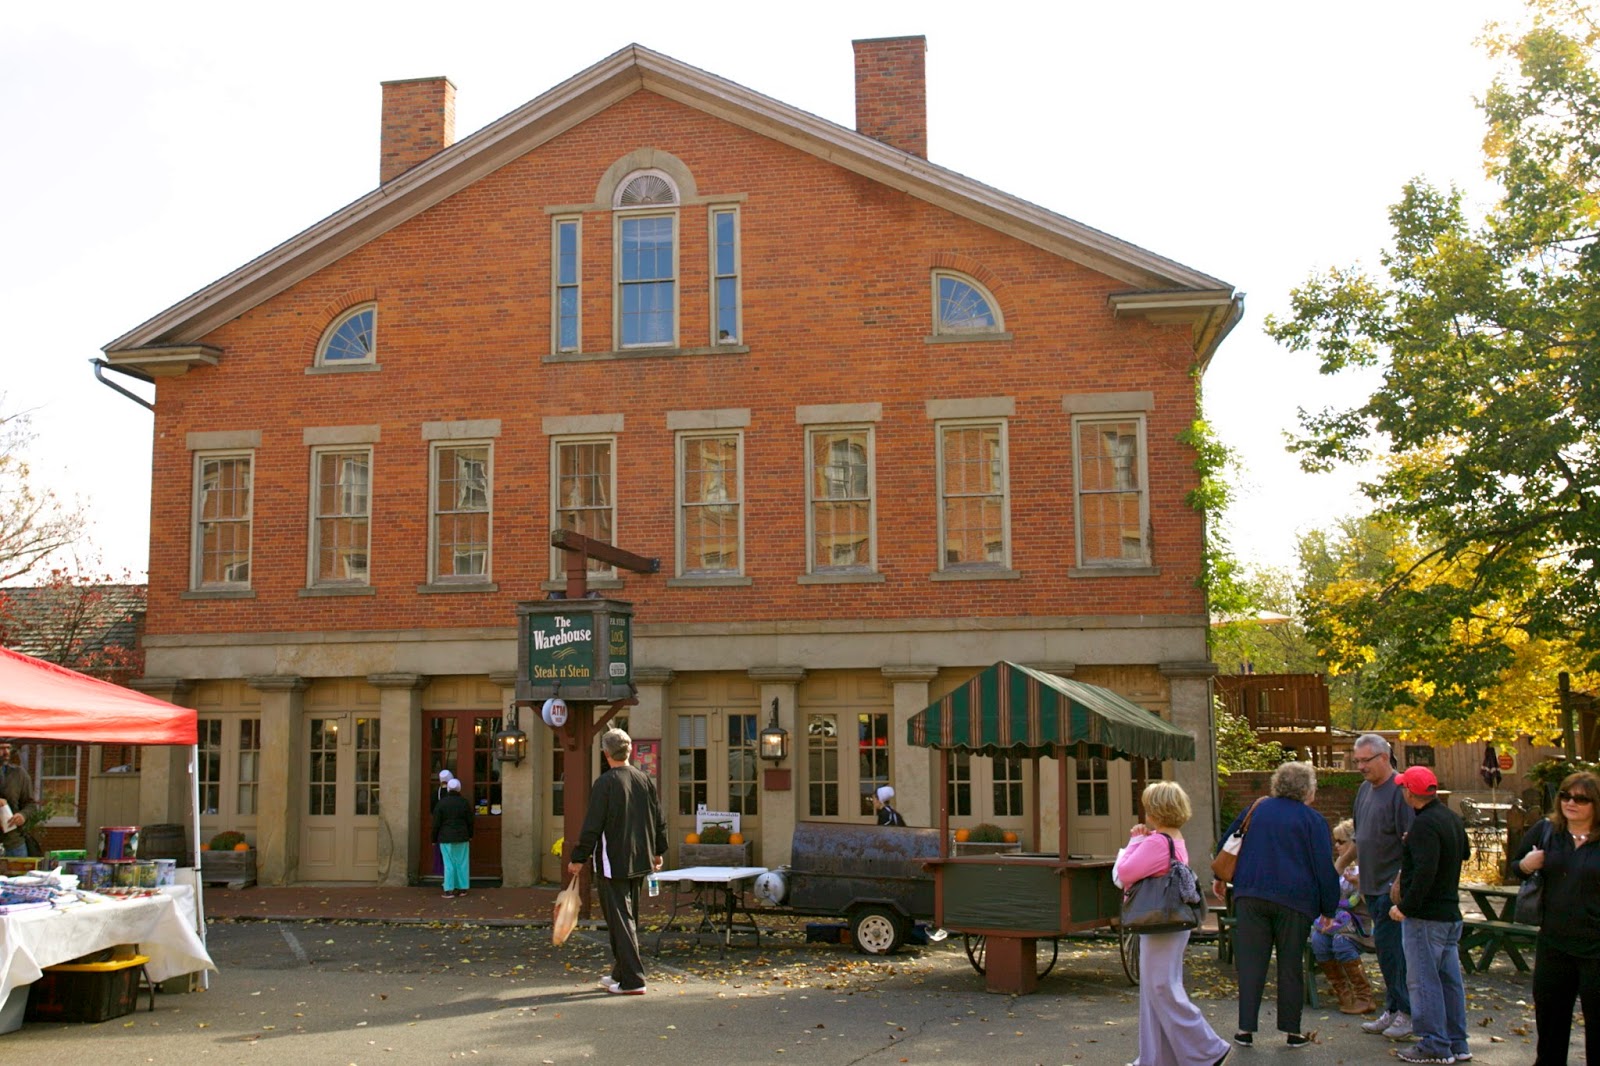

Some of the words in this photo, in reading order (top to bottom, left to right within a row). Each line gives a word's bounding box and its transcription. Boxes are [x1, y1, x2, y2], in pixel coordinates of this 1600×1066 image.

[554, 616, 571, 628] The
[533, 628, 592, 650] Warehouse
[534, 664, 558, 678] Steak
[568, 664, 590, 678] Stein
[552, 704, 566, 716] ATM
